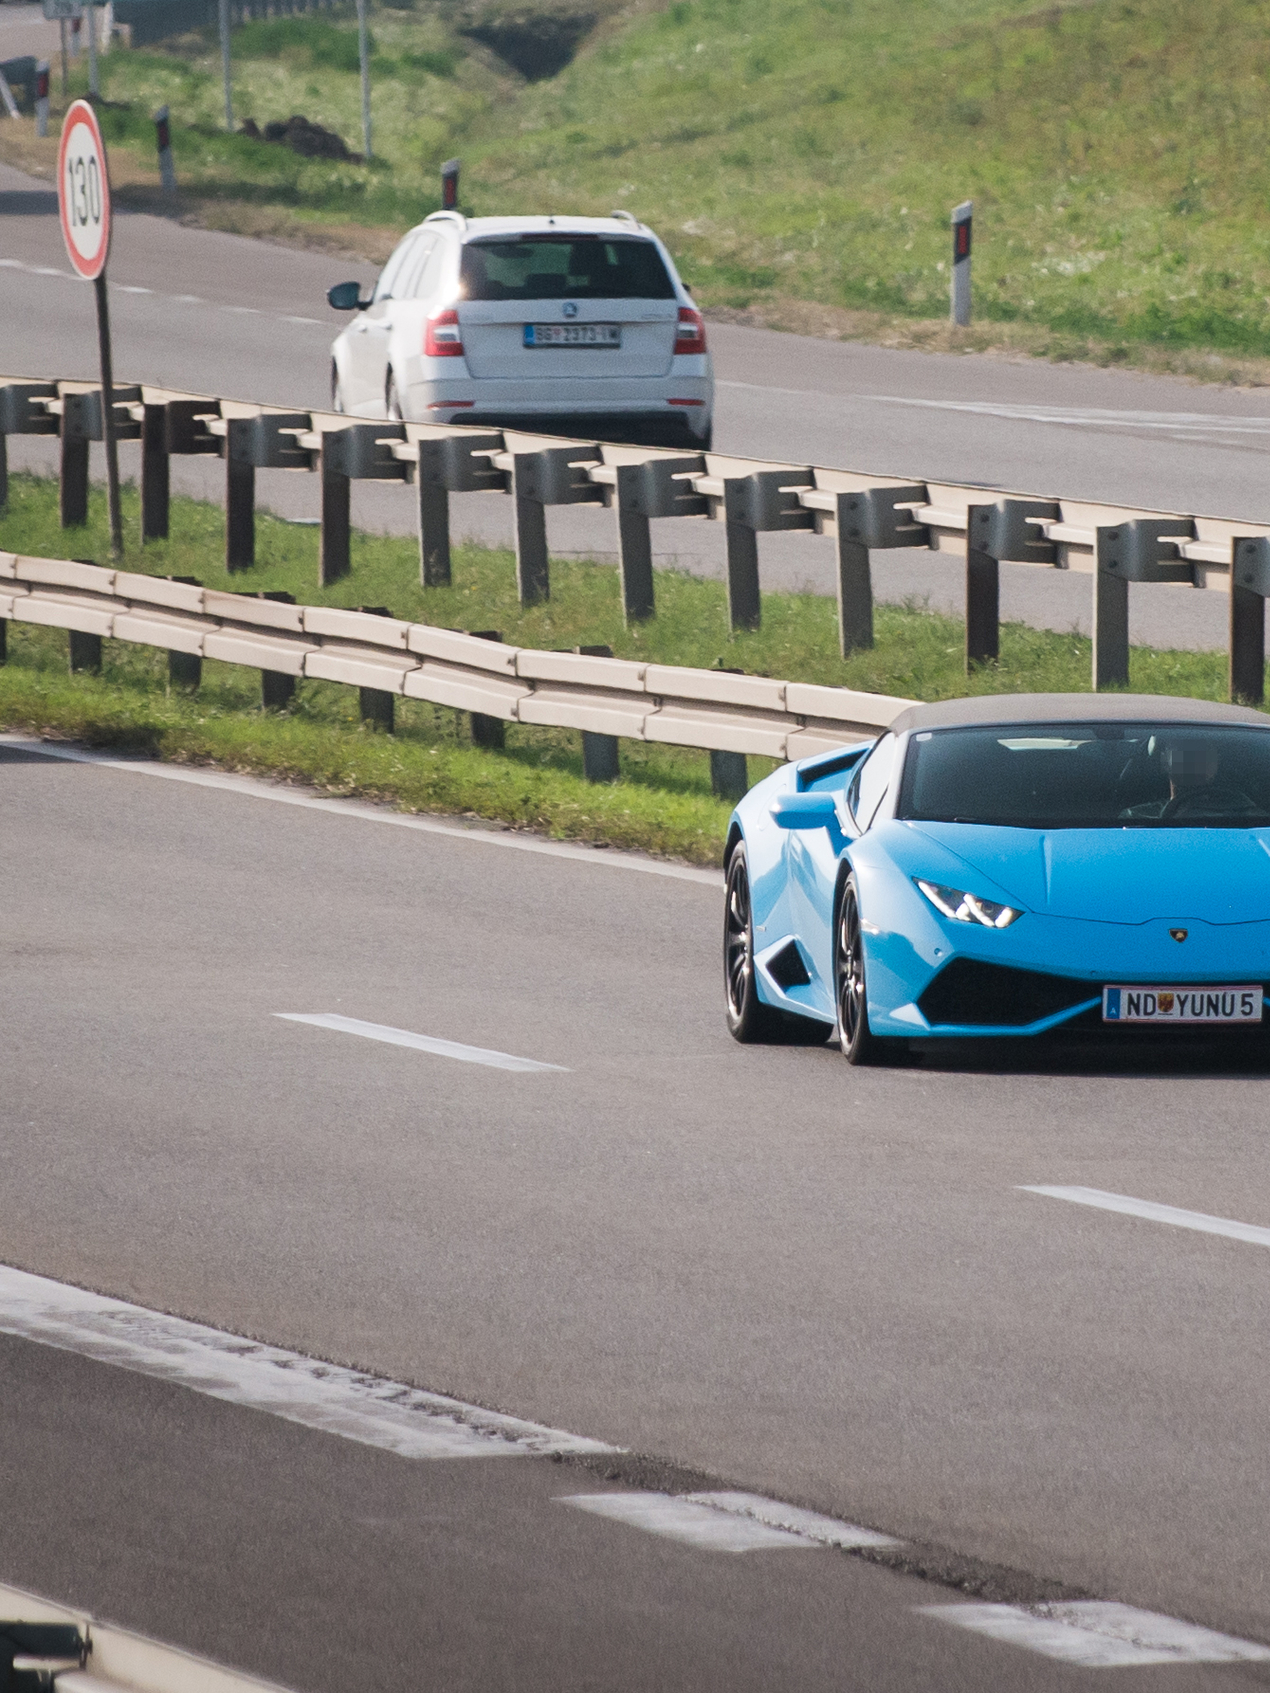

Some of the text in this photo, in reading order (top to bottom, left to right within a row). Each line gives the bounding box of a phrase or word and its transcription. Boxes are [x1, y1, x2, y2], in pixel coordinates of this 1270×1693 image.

[68, 155, 100, 226] 130
[1127, 993, 1253, 1016] ND YUNU 5
